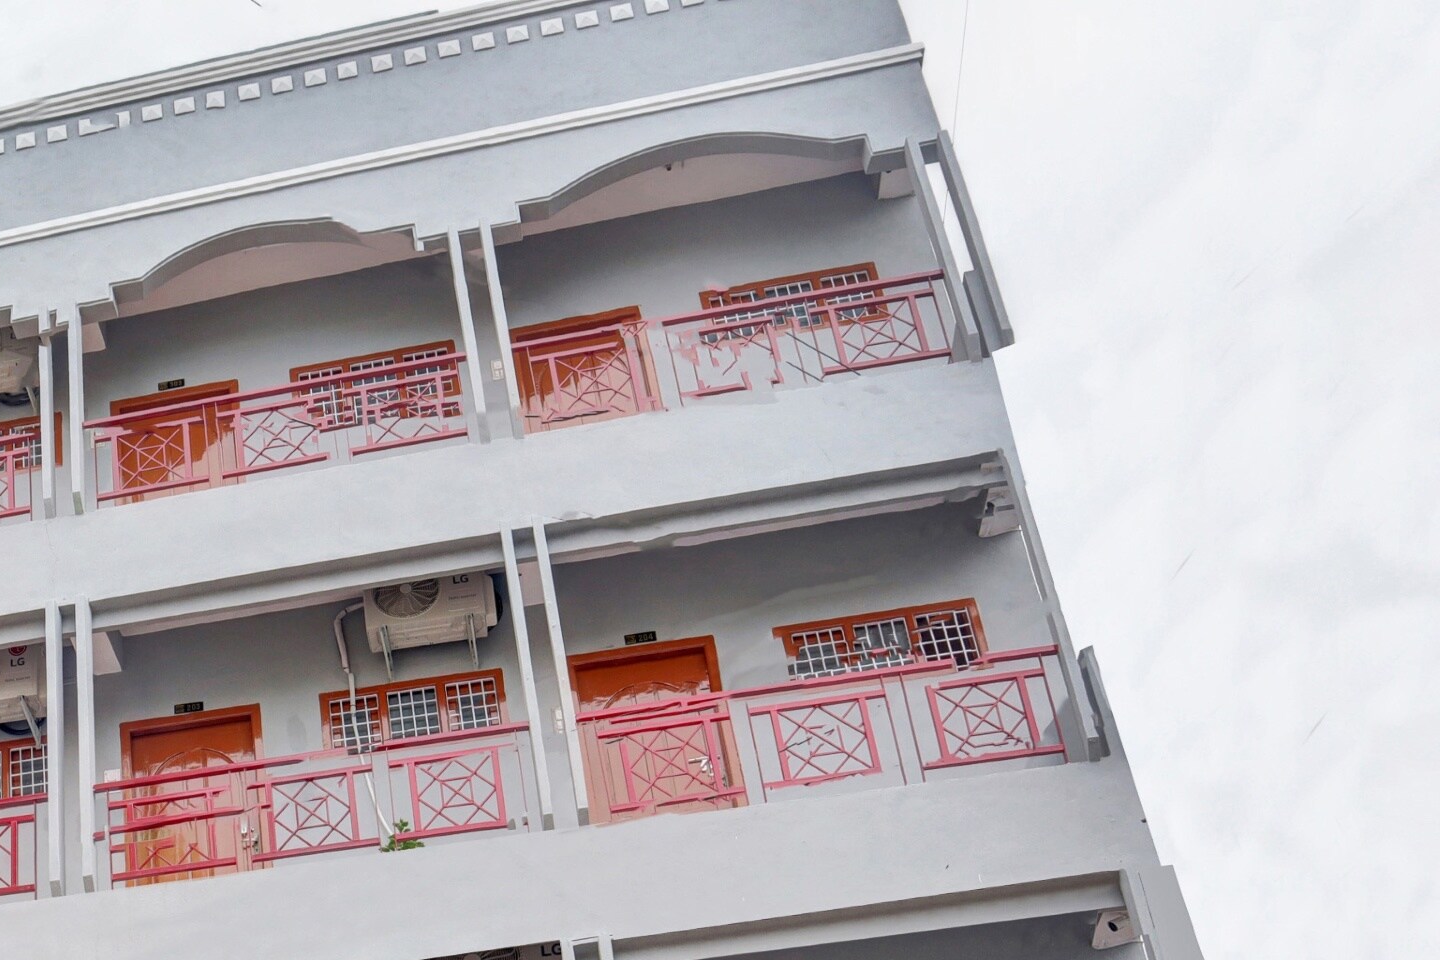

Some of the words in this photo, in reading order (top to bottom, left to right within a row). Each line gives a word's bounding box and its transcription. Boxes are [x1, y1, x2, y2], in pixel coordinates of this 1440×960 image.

[452, 575, 469, 584] LG
[638, 633, 654, 641] 204
[10, 657, 25, 667] LG
[540, 943, 562, 957] LG
